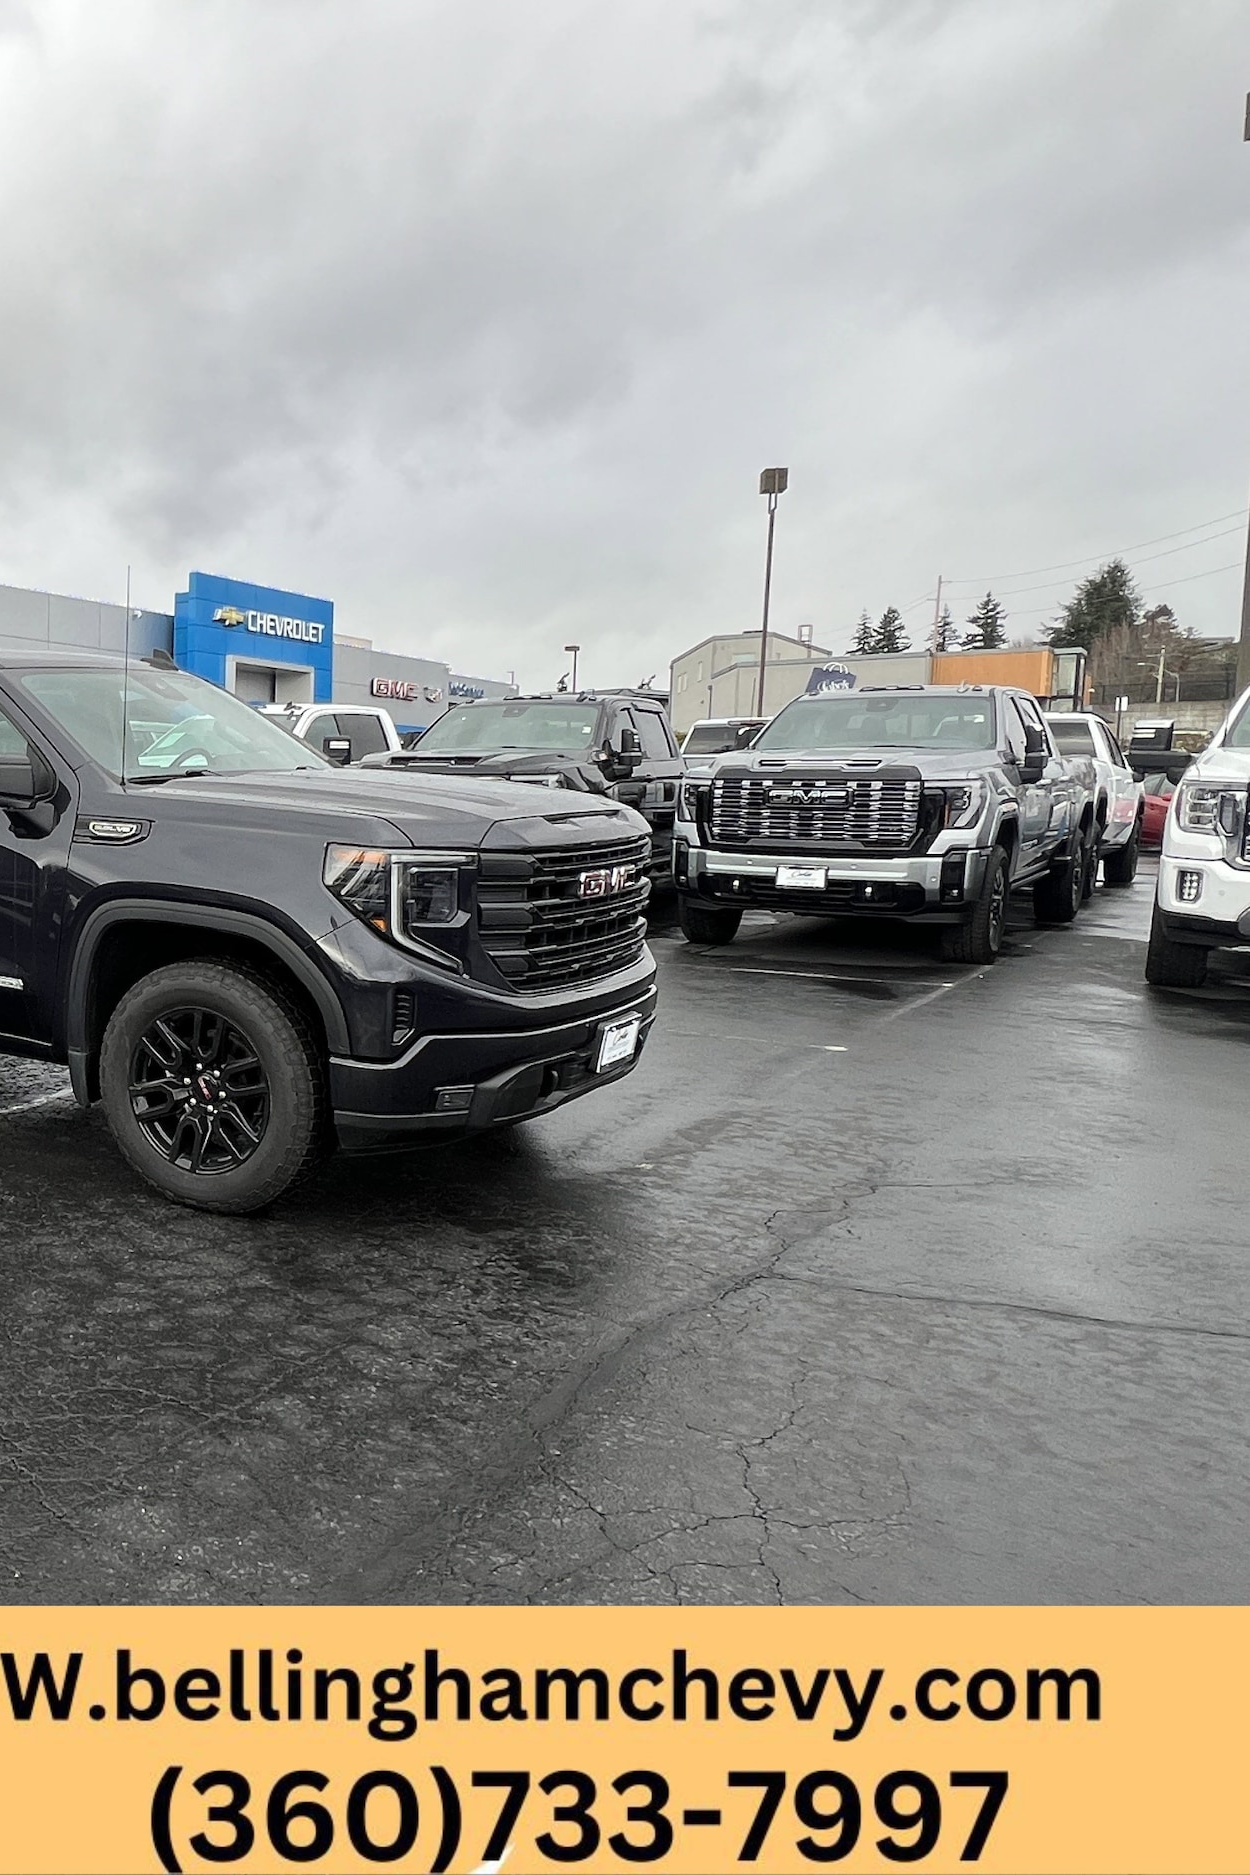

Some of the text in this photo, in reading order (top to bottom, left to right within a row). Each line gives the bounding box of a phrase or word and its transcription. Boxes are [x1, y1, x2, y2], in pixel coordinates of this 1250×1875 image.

[247, 610, 325, 643] CHEVROLET
[371, 678, 418, 701] GMC
[769, 789, 847, 803] GMC
[579, 864, 637, 899] GMC
